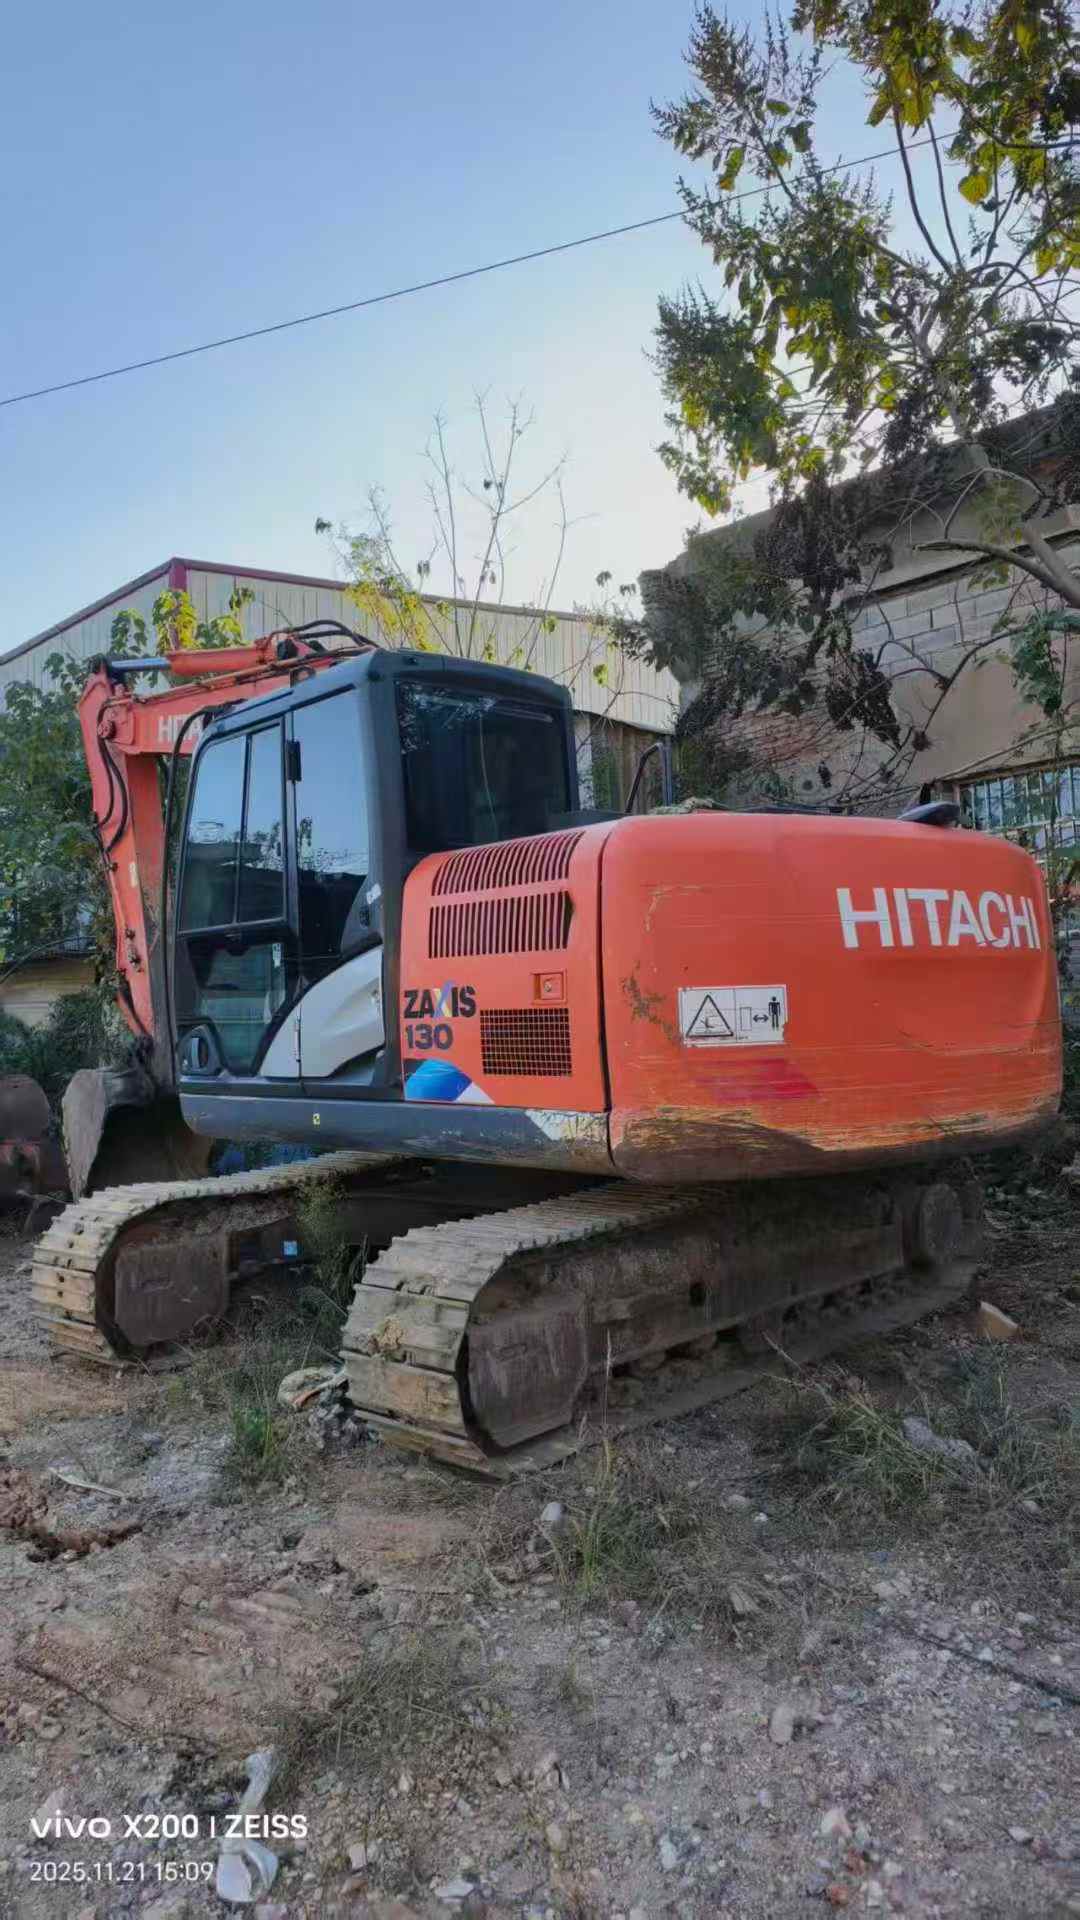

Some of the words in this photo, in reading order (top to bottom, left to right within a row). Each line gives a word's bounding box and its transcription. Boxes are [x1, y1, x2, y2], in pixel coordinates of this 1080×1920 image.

[836, 887, 1041, 950] HITACHI
[403, 980, 476, 1018] ZAXIS
[405, 1023, 453, 1049] 130
